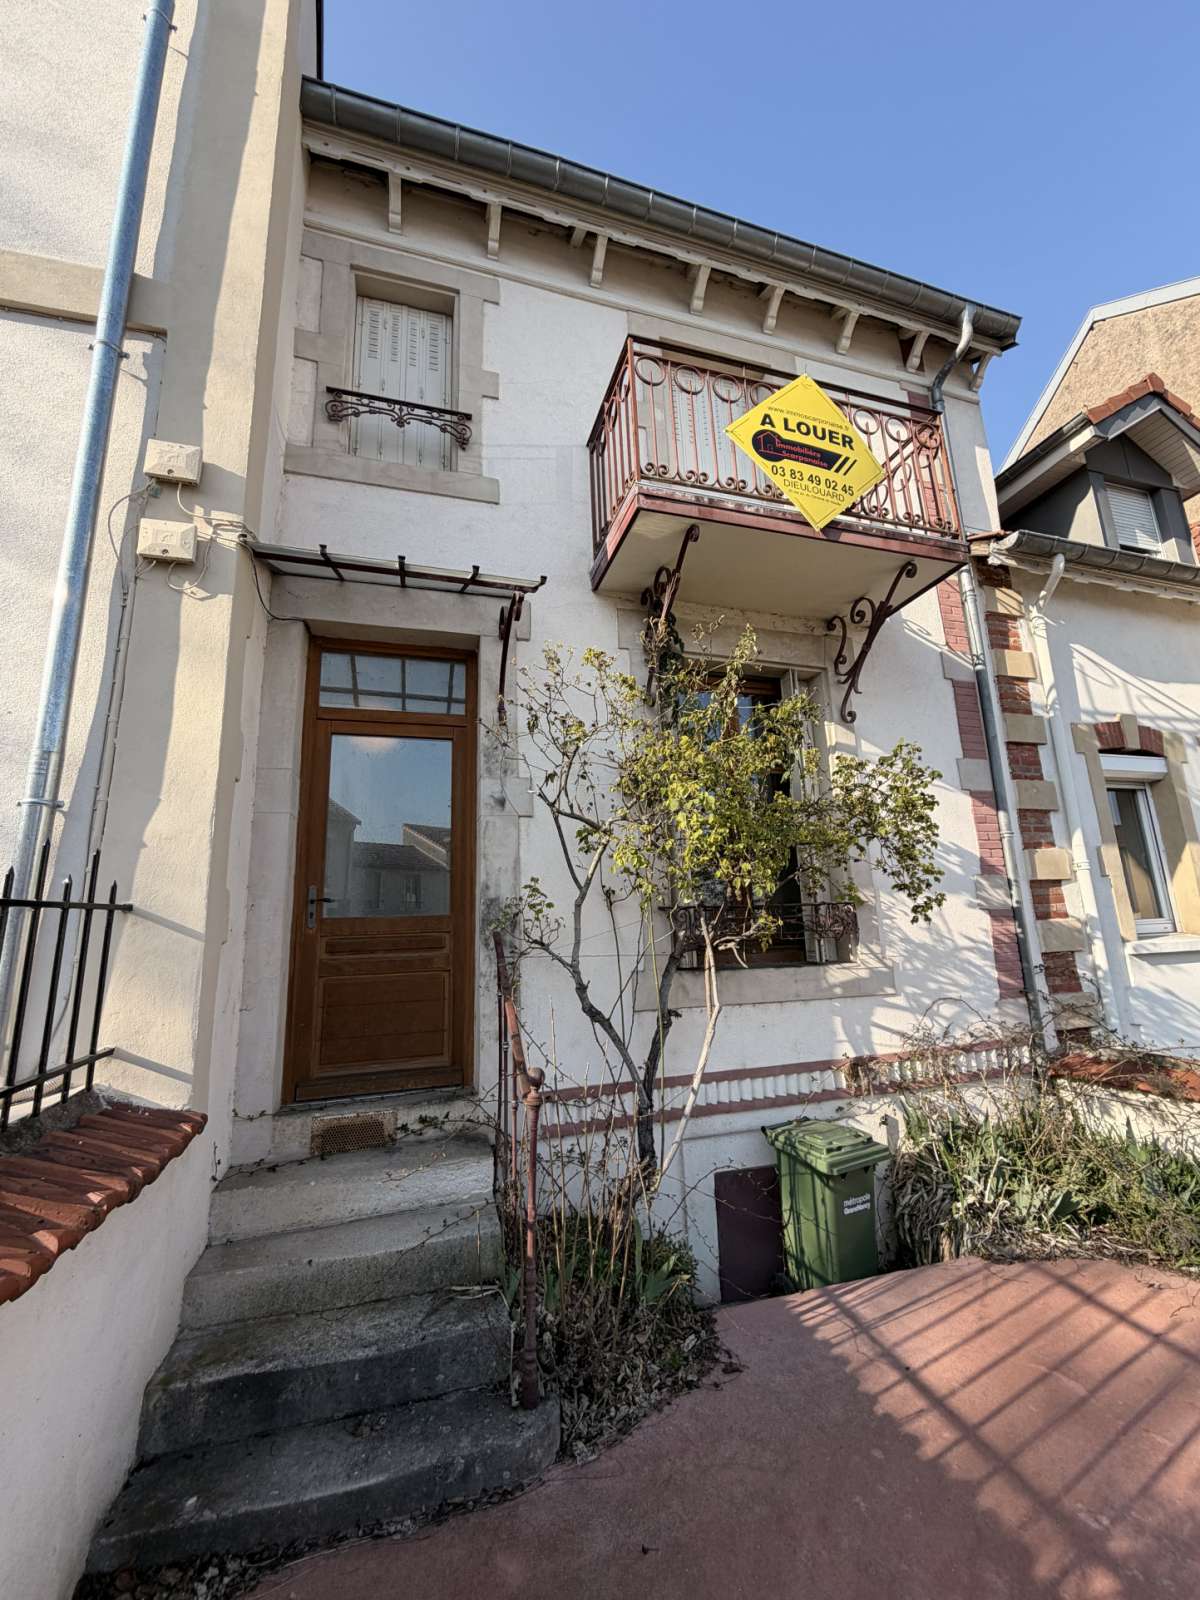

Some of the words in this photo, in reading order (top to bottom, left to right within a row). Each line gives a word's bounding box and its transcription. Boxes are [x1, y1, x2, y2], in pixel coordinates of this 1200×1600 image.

[760, 413, 775, 428] A
[784, 417, 854, 450] LOUER
[771, 465, 786, 477] 03
[789, 470, 804, 481] 83
[807, 475, 821, 486] 49
[825, 478, 838, 491] 02
[841, 484, 854, 497] 45
[783, 479, 845, 502] DIEULOUARD
